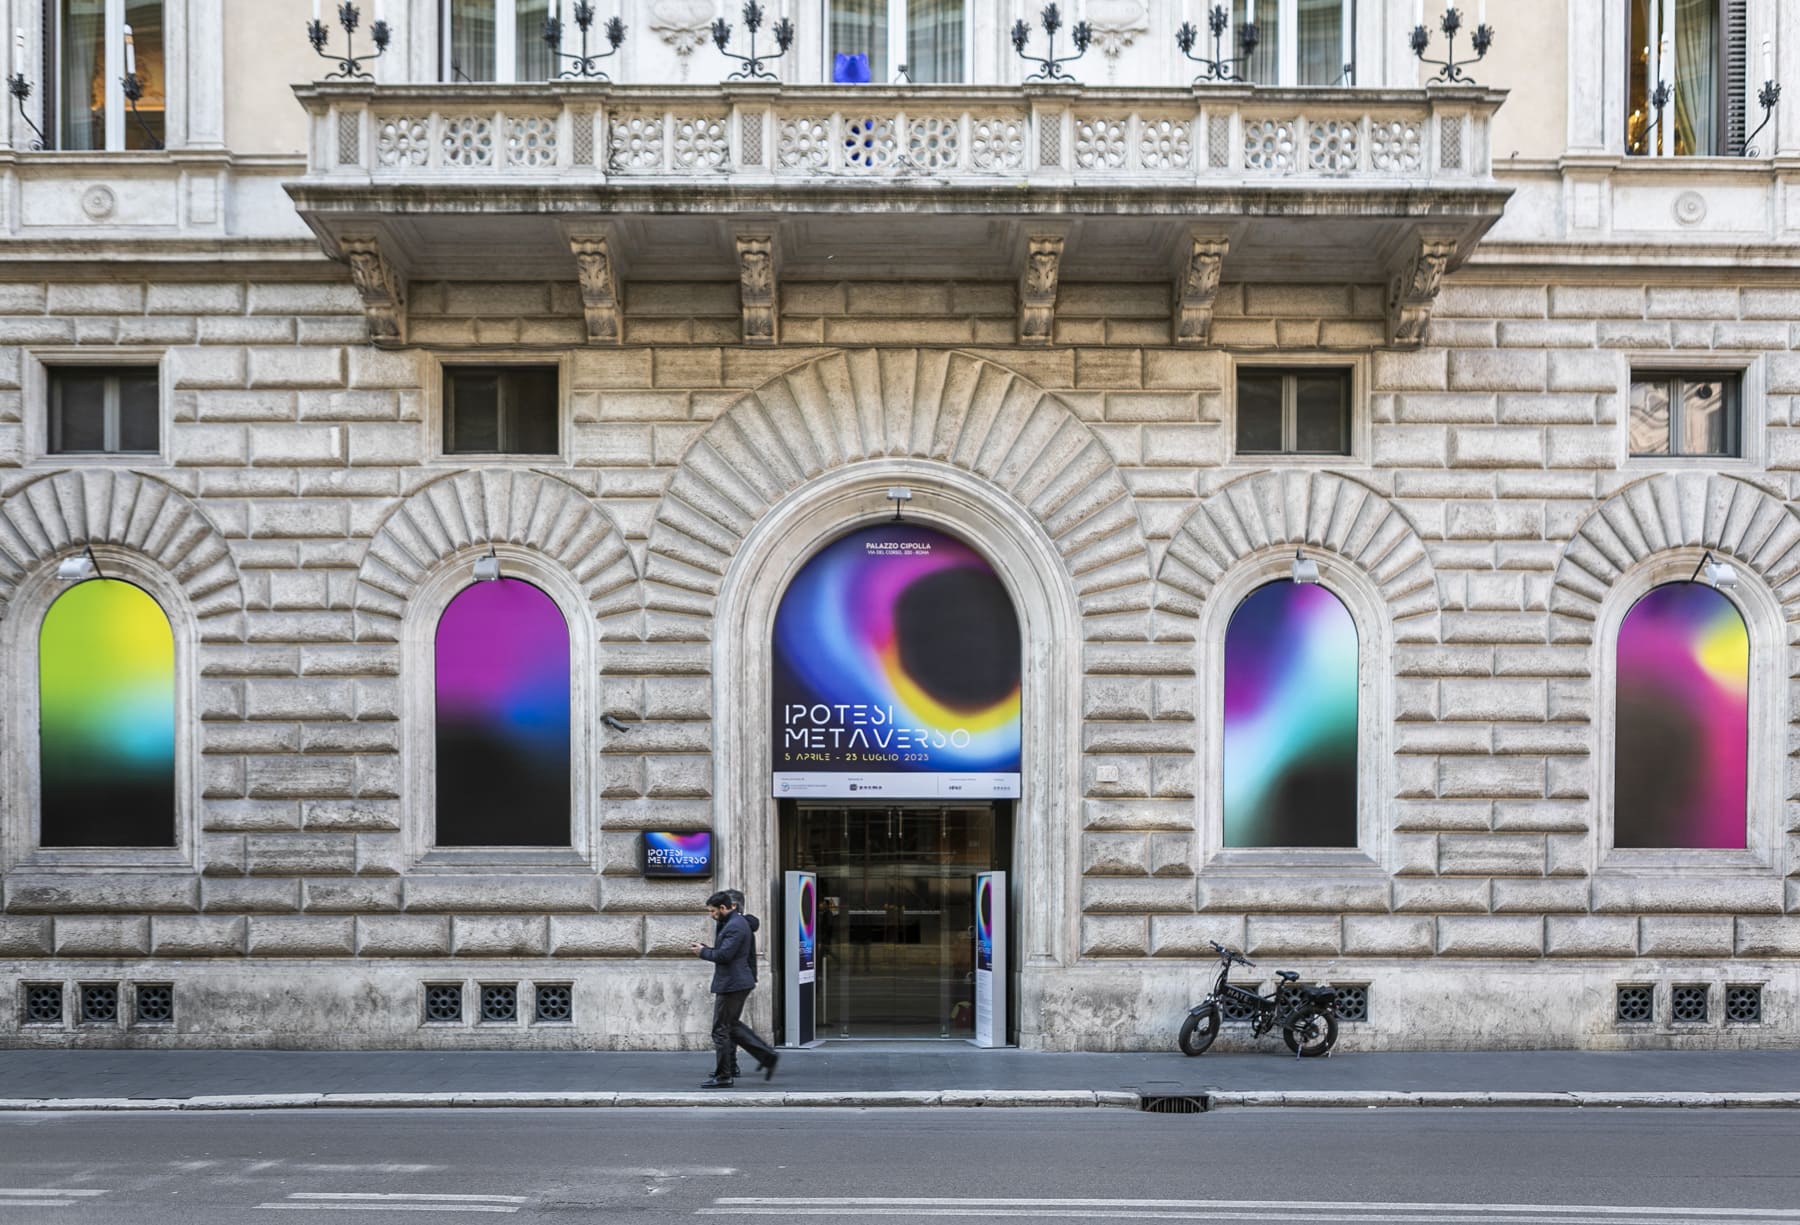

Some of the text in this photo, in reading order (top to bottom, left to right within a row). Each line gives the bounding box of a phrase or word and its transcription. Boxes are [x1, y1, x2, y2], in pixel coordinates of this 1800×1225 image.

[866, 542, 931, 550] PALAZZO CIPOLLA
[785, 704, 893, 725] IPOTESI
[785, 728, 970, 748] METAVERSO
[784, 753, 791, 761] 5
[796, 753, 831, 761] APRILE
[845, 753, 858, 761] 23
[862, 753, 899, 761] LUGLIO
[904, 753, 929, 761] 2023
[647, 849, 683, 857] IPOTESI
[647, 856, 708, 865] METAVERSO
